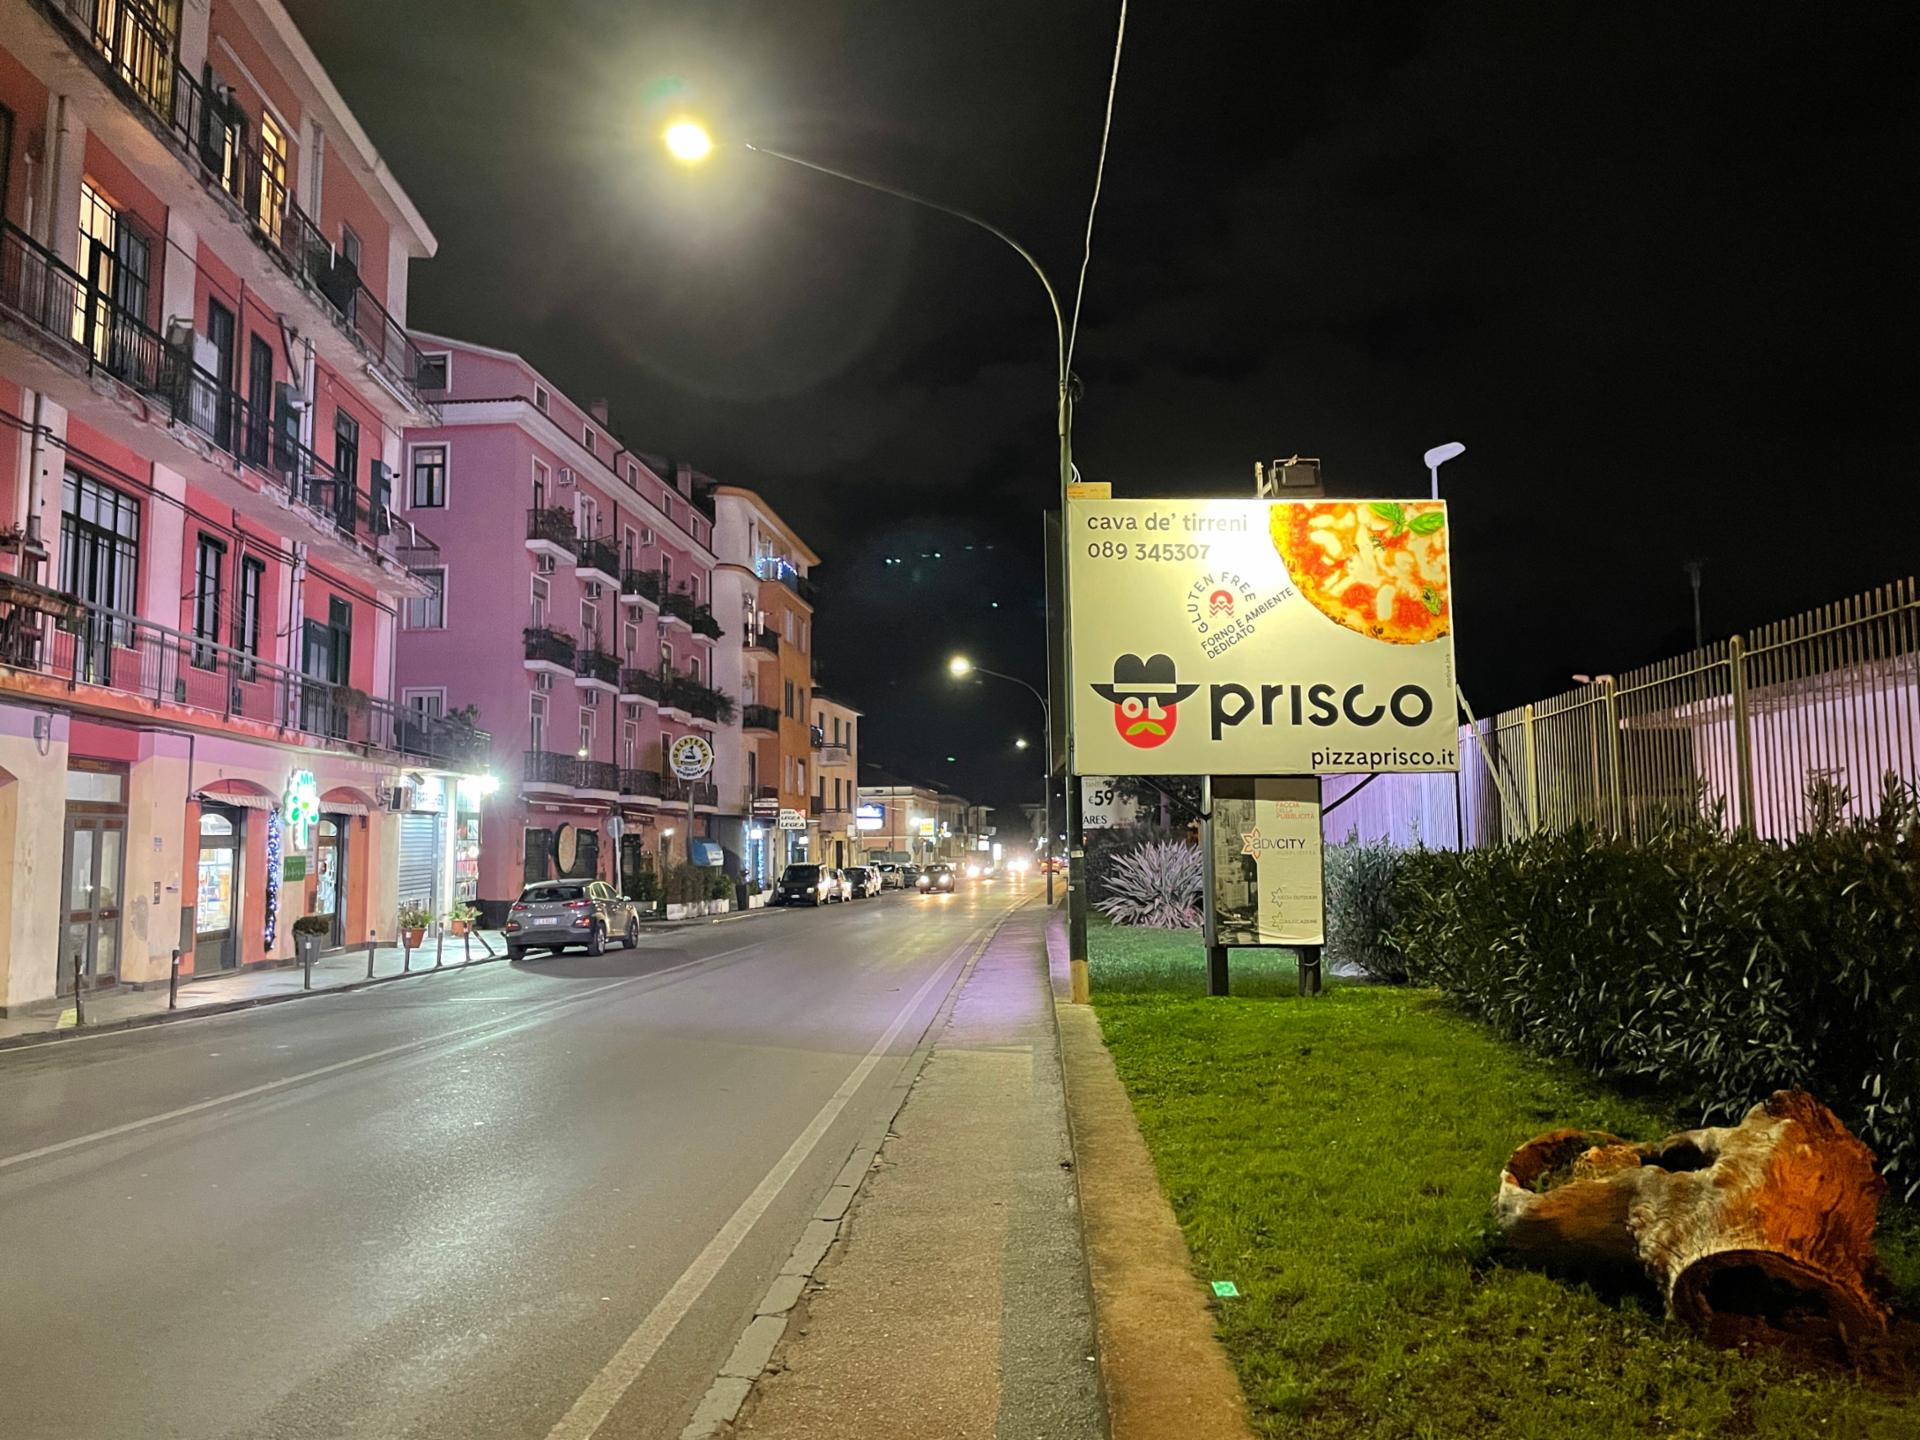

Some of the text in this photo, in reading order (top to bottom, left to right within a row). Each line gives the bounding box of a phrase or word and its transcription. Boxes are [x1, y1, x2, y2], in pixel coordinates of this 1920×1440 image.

[1087, 512, 1248, 532] cava de' tirreni
[1087, 541, 1211, 562] 089 345307
[1187, 571, 1256, 634] GLUTEN FREE
[1200, 587, 1294, 651] FORNO E AMBIENTE
[1206, 624, 1256, 659] DEDICATO
[1209, 683, 1433, 741] prisco
[1311, 747, 1455, 769] pizzaprisco.it
